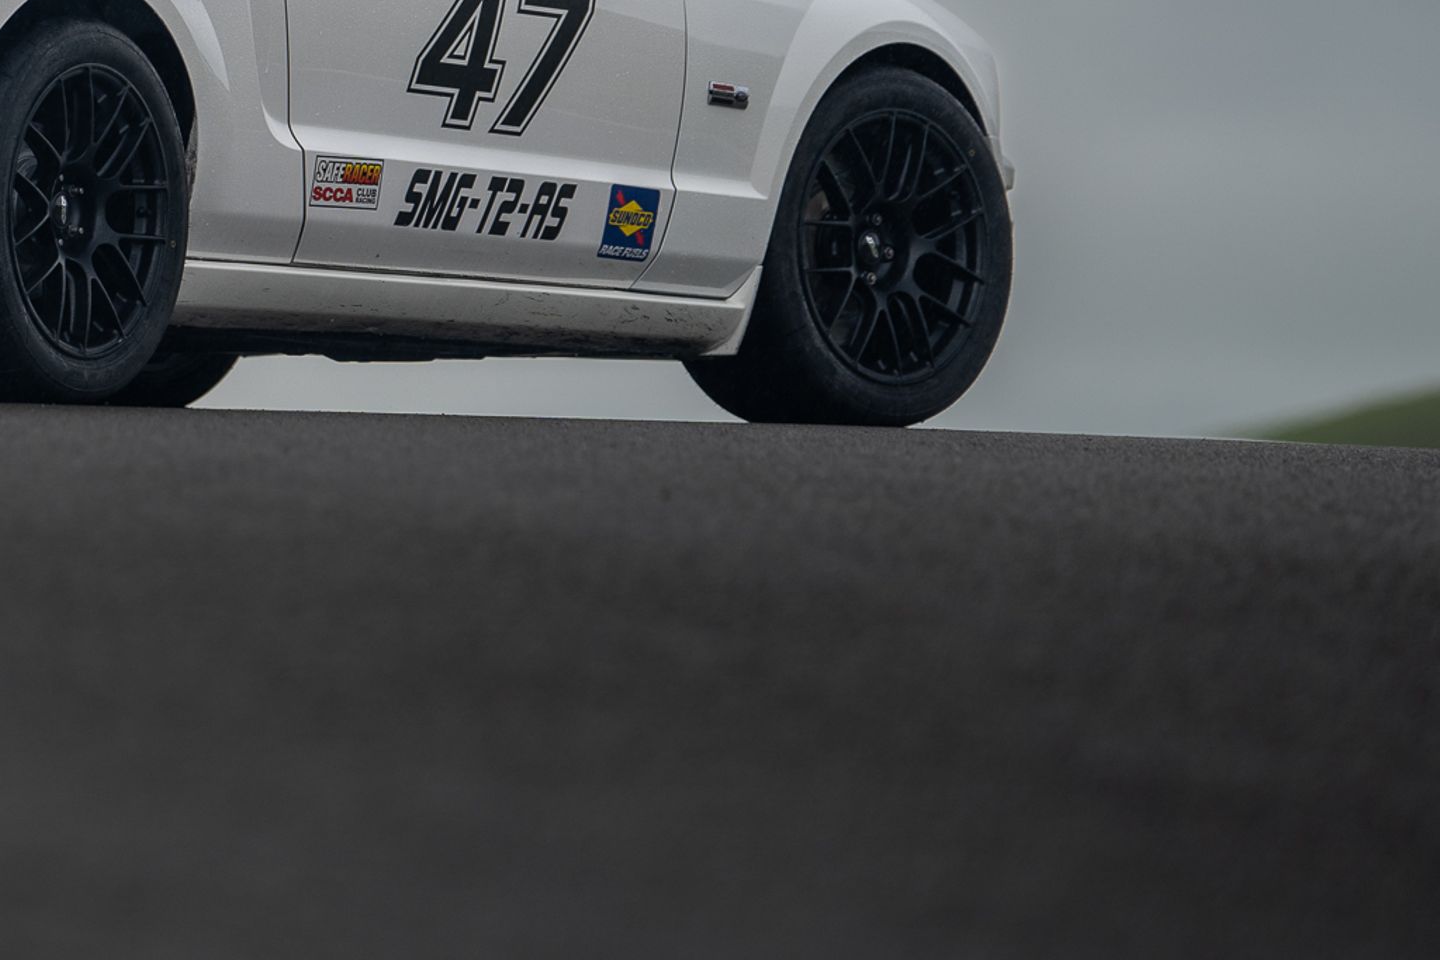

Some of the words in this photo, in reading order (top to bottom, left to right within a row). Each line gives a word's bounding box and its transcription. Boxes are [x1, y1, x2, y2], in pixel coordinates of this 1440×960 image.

[312, 186, 353, 202] SCCA
[356, 187, 377, 197] CLUB
[393, 168, 578, 241] SMG-T2-AS
[610, 209, 652, 227] SUNOCO
[599, 245, 624, 256] RACE
